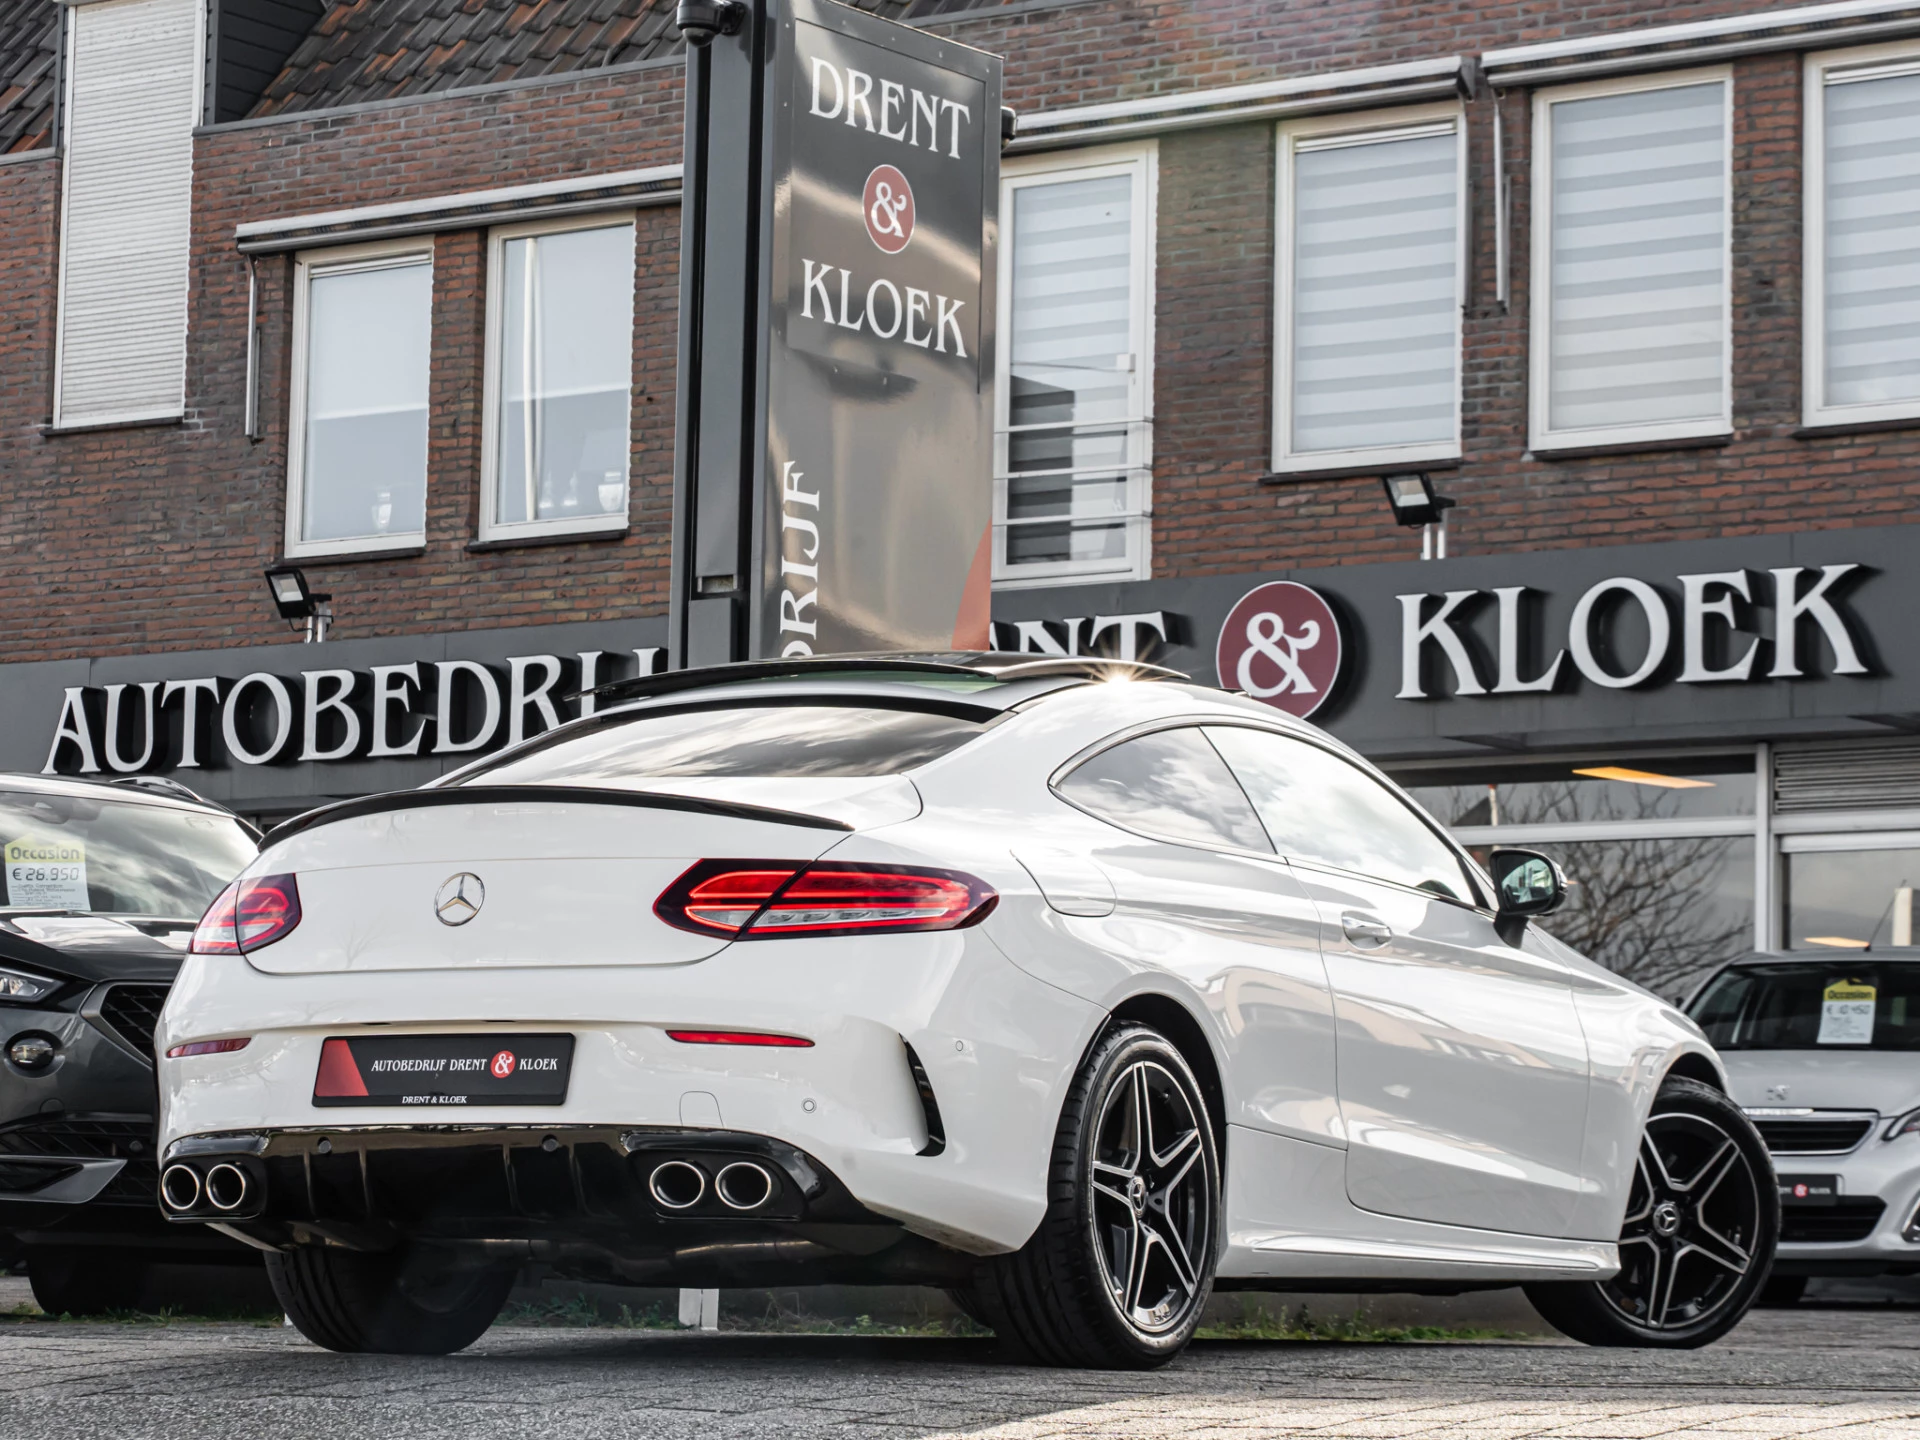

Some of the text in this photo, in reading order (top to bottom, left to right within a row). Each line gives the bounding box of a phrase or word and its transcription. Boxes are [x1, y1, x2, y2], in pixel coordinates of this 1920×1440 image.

[809, 56, 970, 159] DRENT
[871, 182, 907, 238] &
[800, 259, 968, 358] KLOEK
[1238, 612, 1320, 698] &
[1395, 563, 1869, 699] KLOEK
[11, 846, 80, 860] Occasion
[12, 868, 22, 881] €
[371, 1053, 558, 1074] AUTOBEDRIJF DRENT & KLOEK
[402, 1096, 430, 1104] DRENT
[438, 1095, 467, 1104] KLOEK
